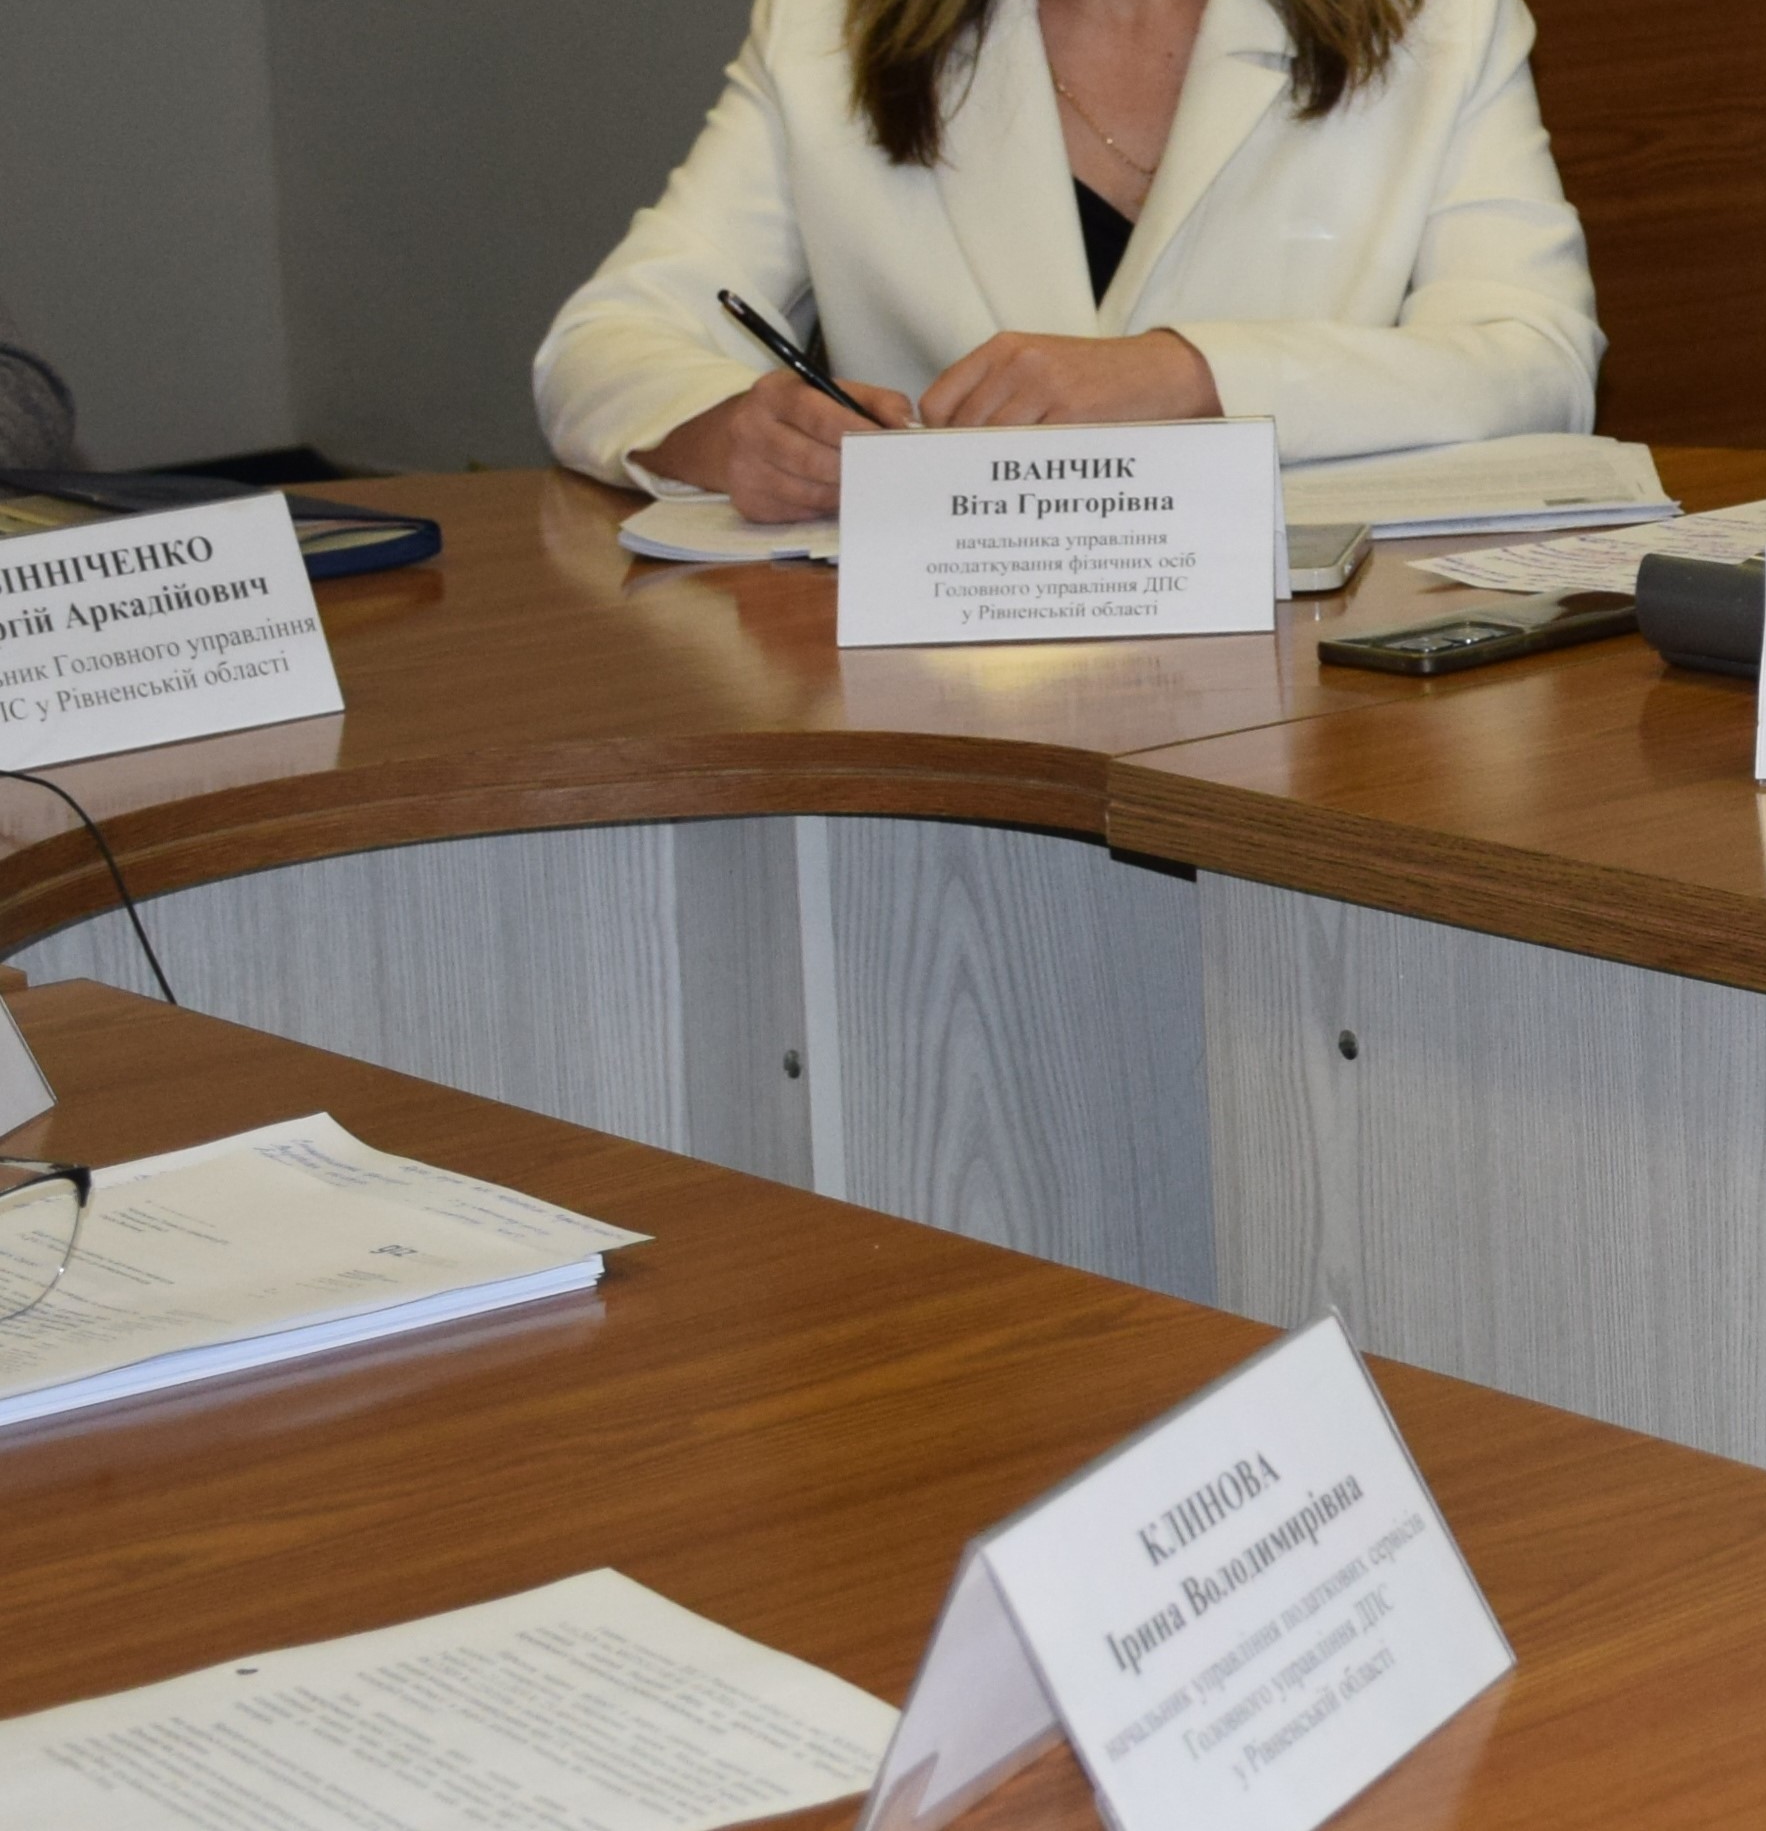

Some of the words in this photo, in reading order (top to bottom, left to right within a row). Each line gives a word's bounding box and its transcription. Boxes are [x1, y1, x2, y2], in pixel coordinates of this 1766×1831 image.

[991, 457, 1137, 482] ІВАНЧИК
[950, 494, 1008, 517] Віта
[1018, 492, 1175, 519] Григорівна
[956, 533, 1060, 551] начальника
[1065, 530, 1168, 550] управління
[0, 536, 213, 595] ІННІЧЕНКО
[926, 556, 1063, 575] оподаткування
[1069, 555, 1152, 573] фізичних
[1159, 553, 1197, 570] осіб
[66, 576, 269, 631] Аркадійович
[933, 581, 1031, 598] Головного
[1035, 577, 1138, 599] управління
[1144, 576, 1189, 594] ДПС
[961, 607, 973, 624] у
[978, 601, 1086, 621] Рівненській
[1092, 601, 1159, 618] області
[53, 639, 180, 677] Головного
[186, 617, 317, 659] управління
[36, 699, 49, 722] у
[56, 668, 198, 713] Рівненській
[204, 649, 289, 687] області
[1138, 1449, 1281, 1567] КЛИНОВА
[1105, 1600, 1186, 1676] Ірина
[1181, 1471, 1364, 1617] Володимирівна
